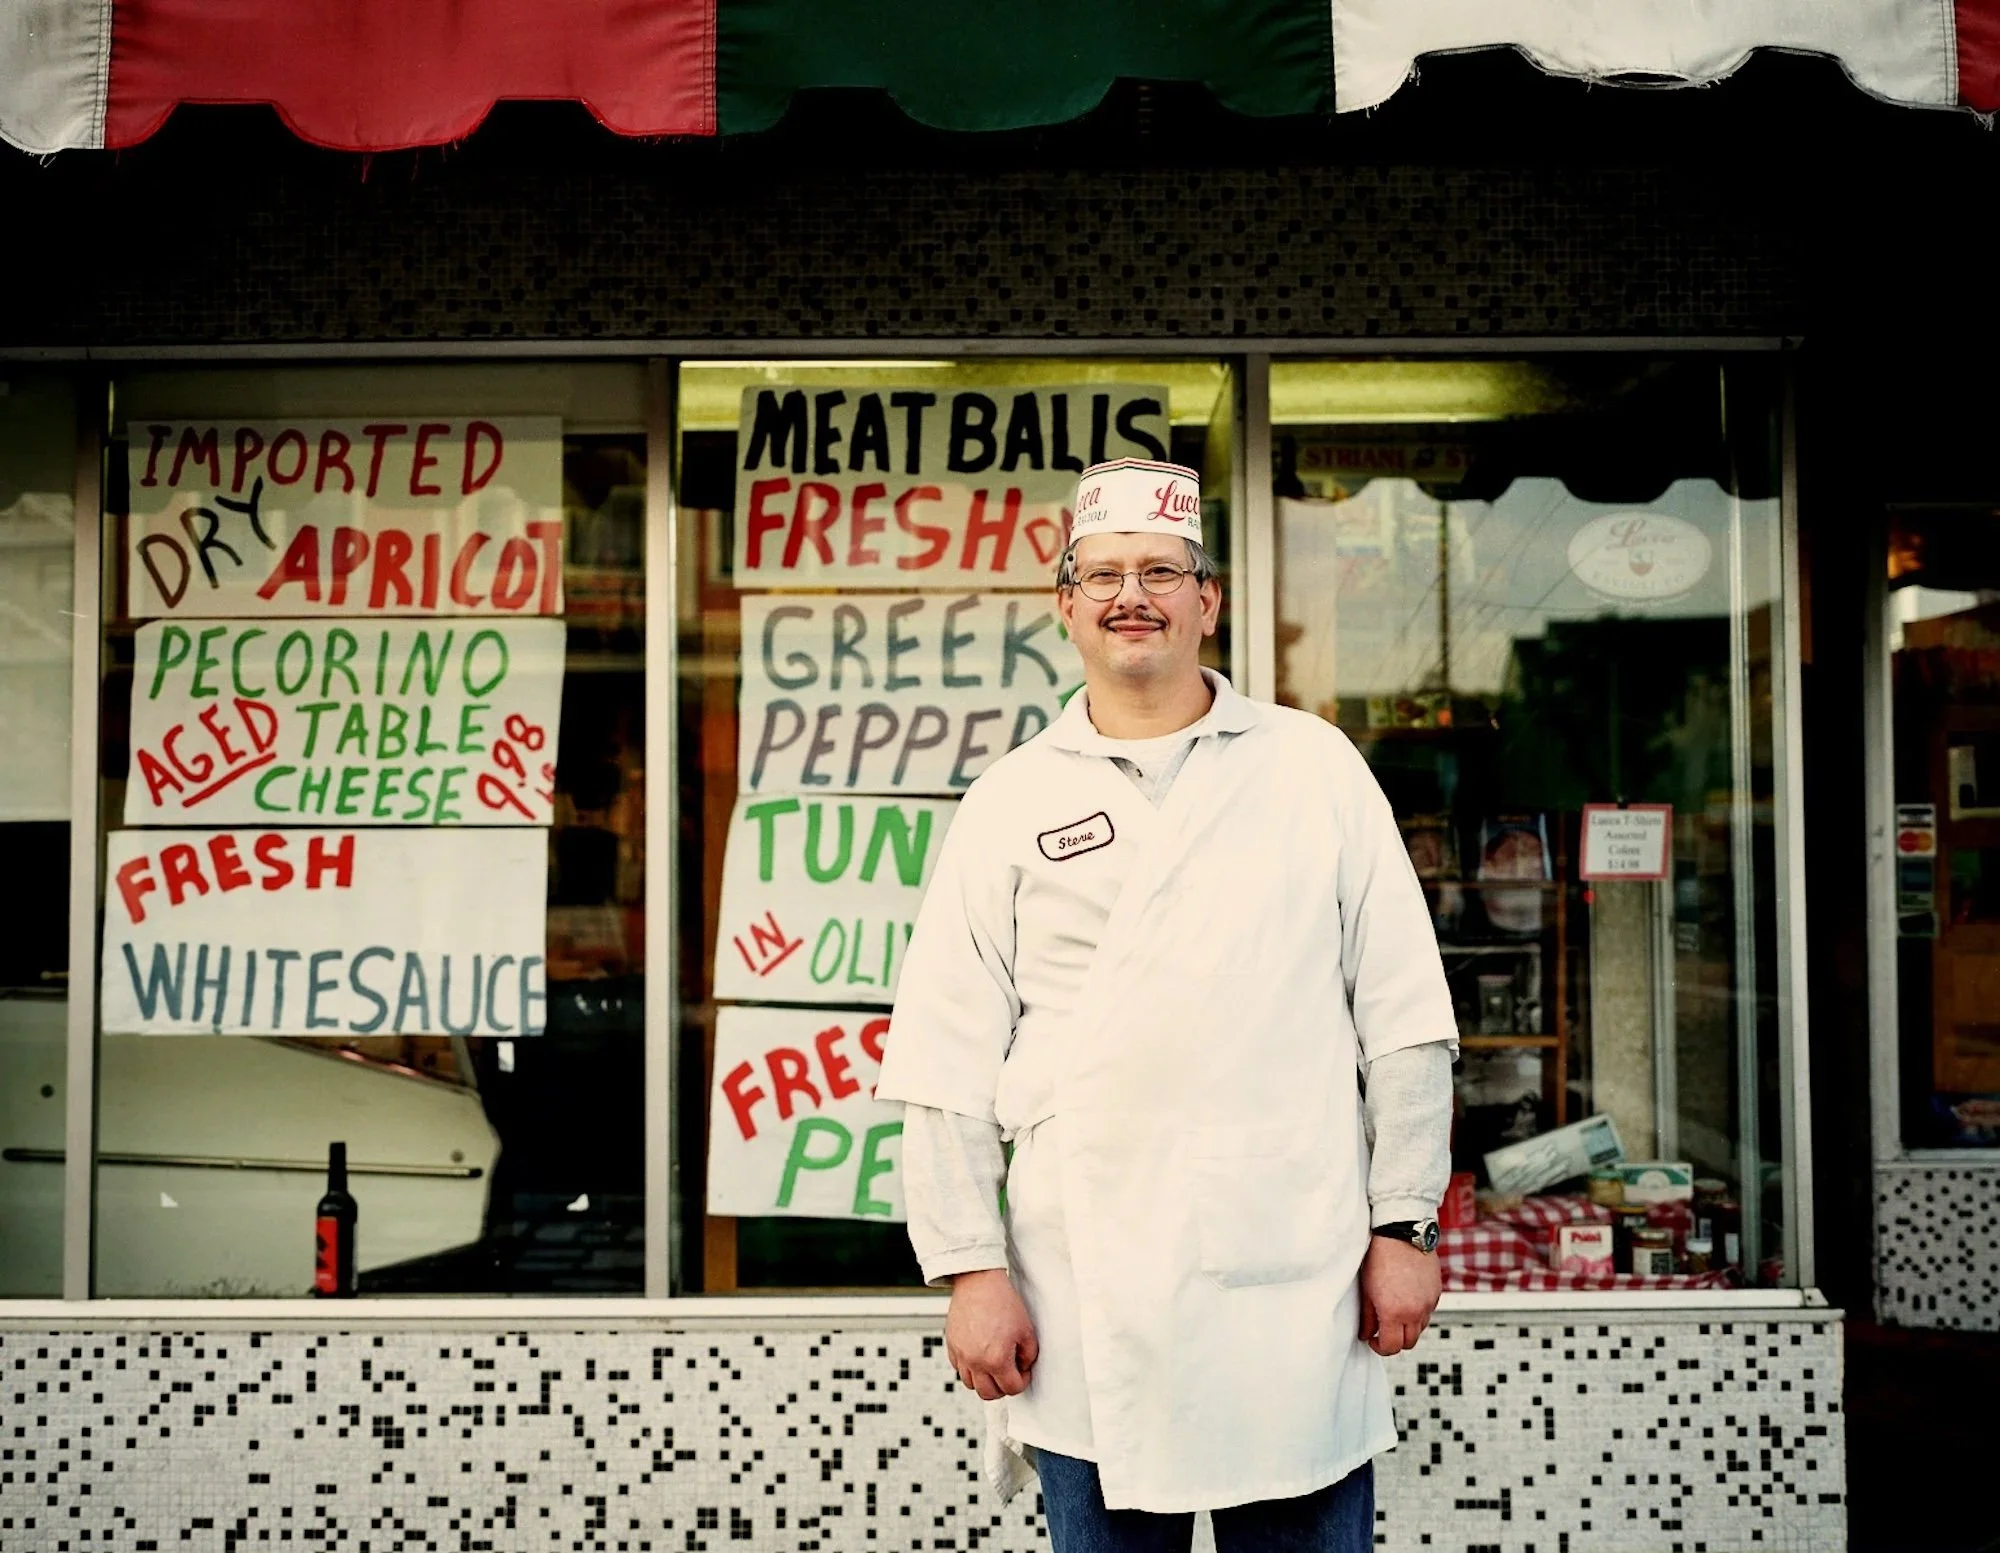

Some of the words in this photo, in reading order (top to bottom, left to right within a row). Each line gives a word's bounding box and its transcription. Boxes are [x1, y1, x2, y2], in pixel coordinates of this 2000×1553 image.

[141, 421, 503, 498] IMPORTED
[138, 476, 277, 609] DRY
[257, 521, 562, 613] APRICOT
[746, 477, 1021, 572] FRESH
[149, 626, 510, 699] PECORINO
[763, 595, 1058, 691] GREEK
[137, 698, 278, 806] AGED
[297, 703, 490, 760] TABLE
[253, 765, 468, 823] CHEESE
[117, 833, 355, 923] FRESH
[1058, 831, 1095, 850] Steve
[733, 911, 791, 973] IN
